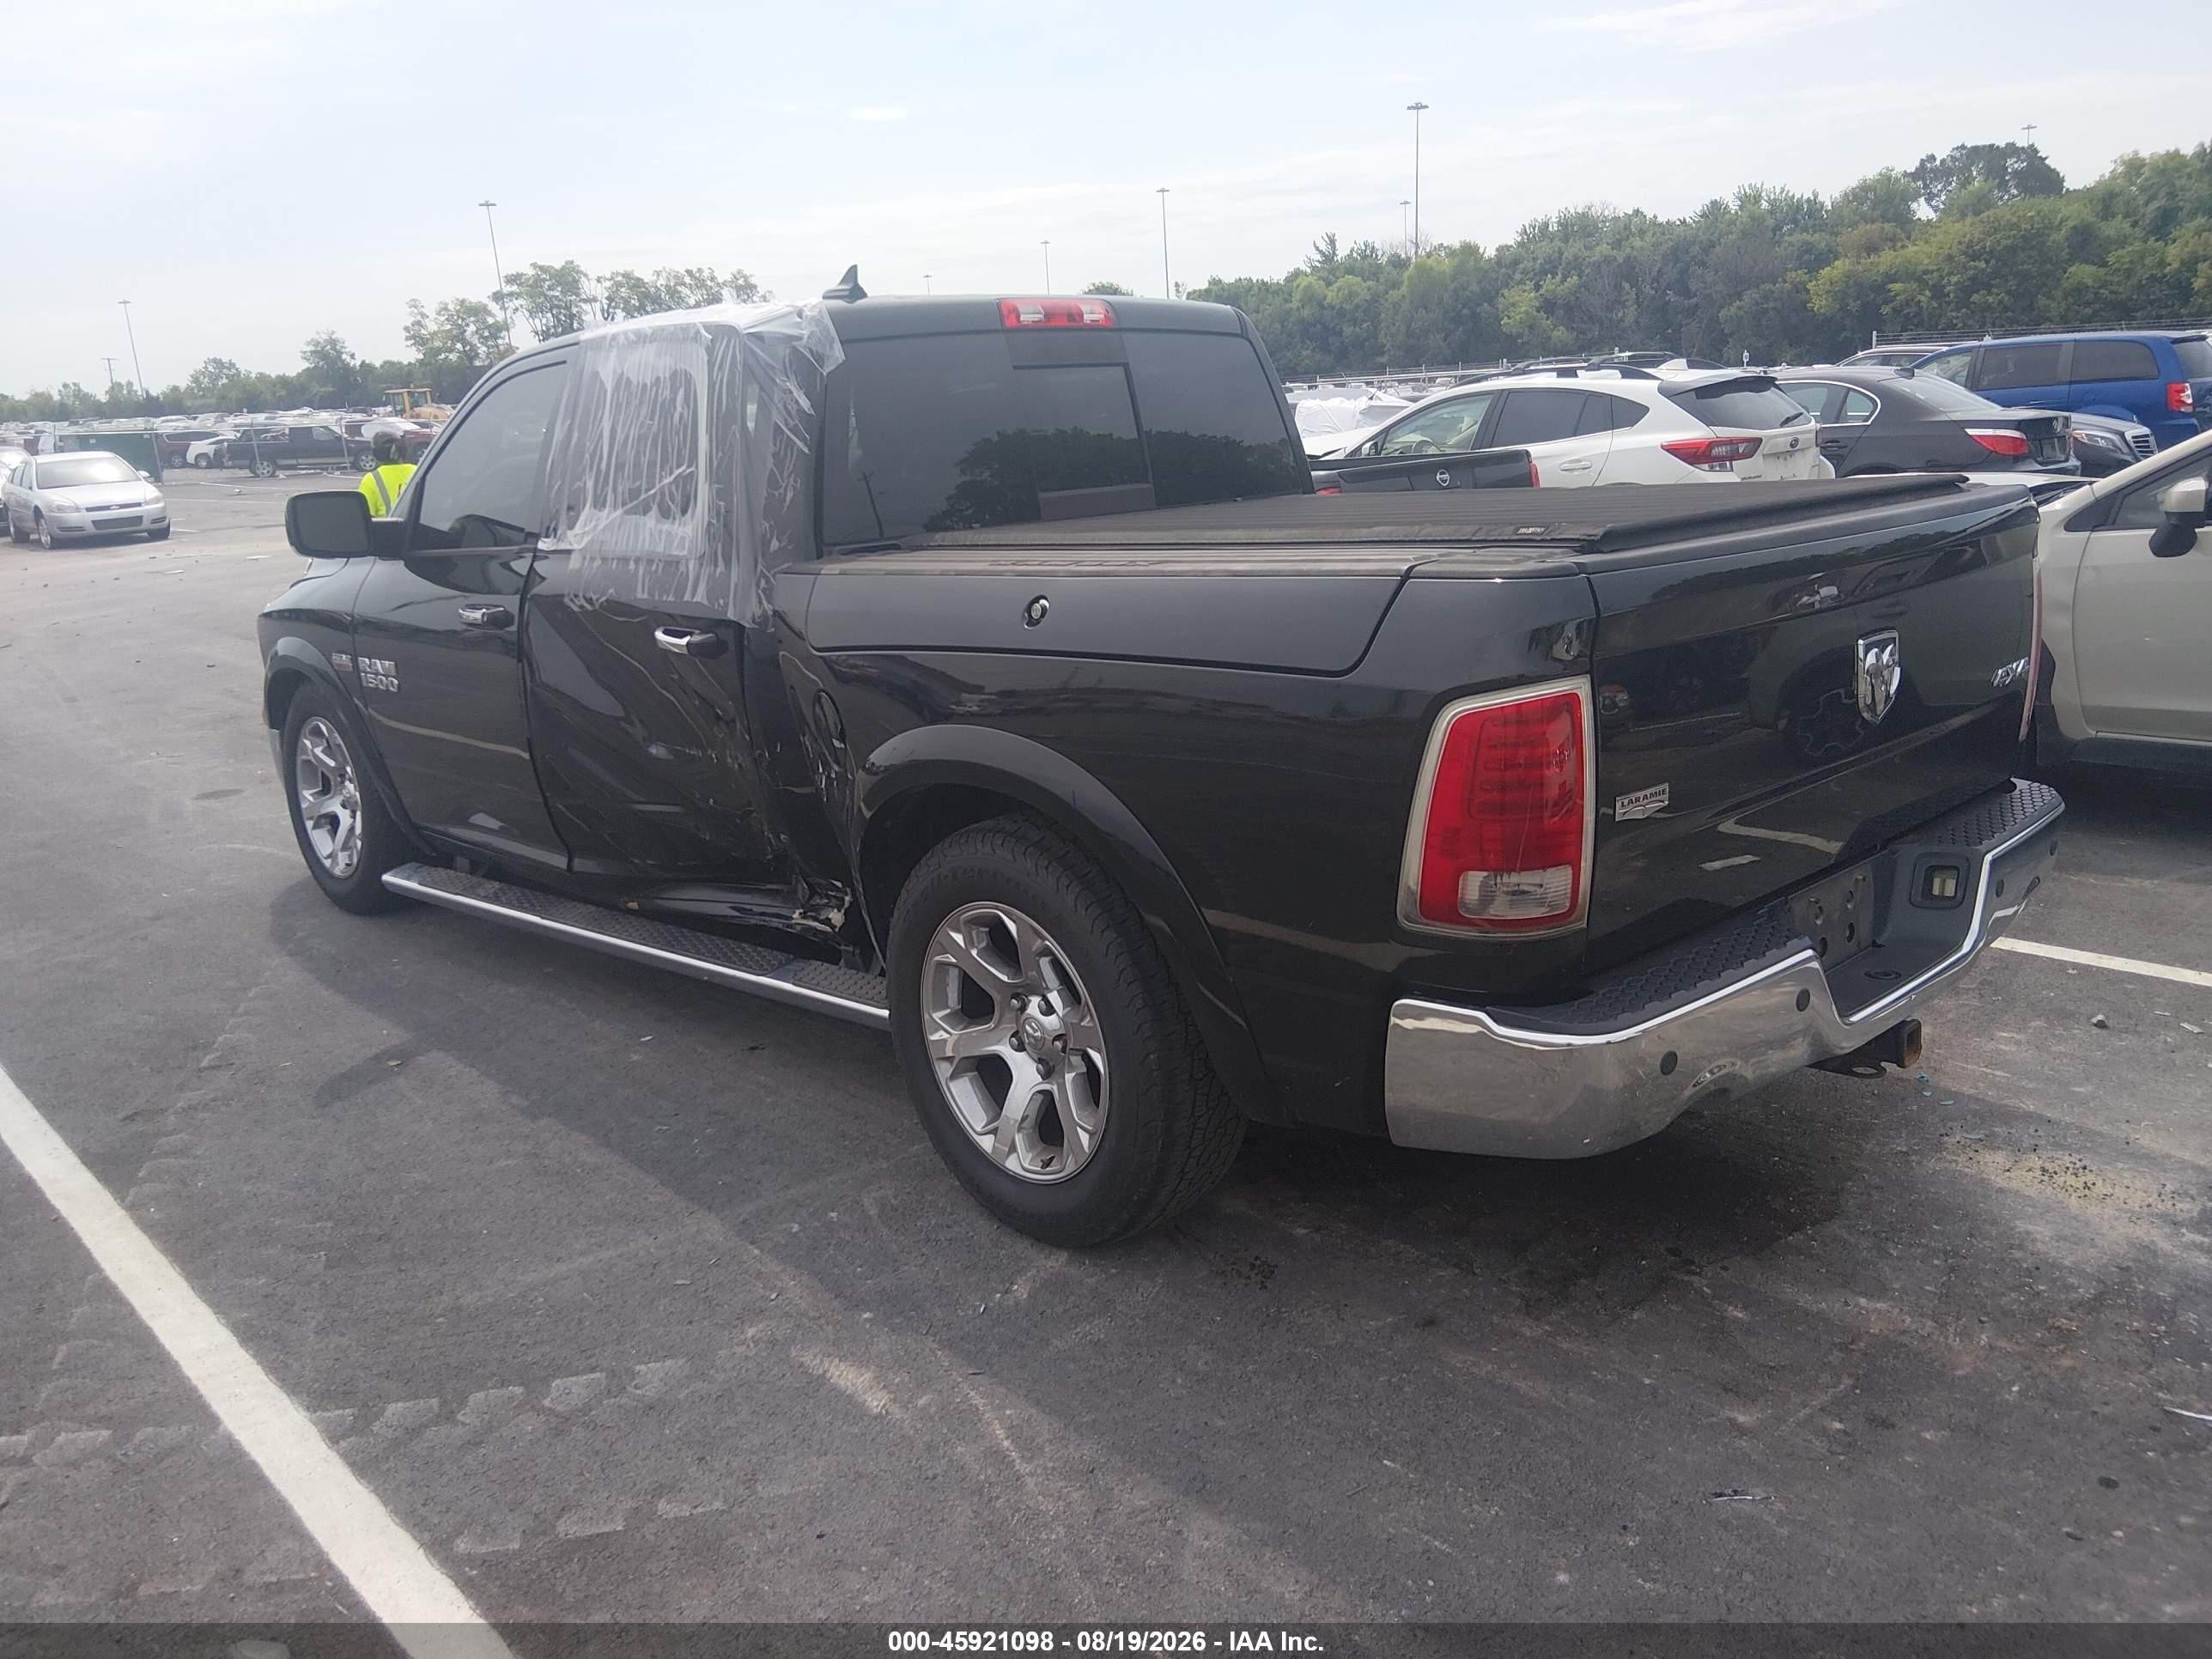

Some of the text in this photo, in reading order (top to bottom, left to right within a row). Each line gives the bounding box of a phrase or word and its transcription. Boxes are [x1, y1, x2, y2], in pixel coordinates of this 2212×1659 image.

[357, 656, 397, 676] RAM
[360, 672, 399, 693] 1500
[1620, 787, 1668, 808] LARAMIE
